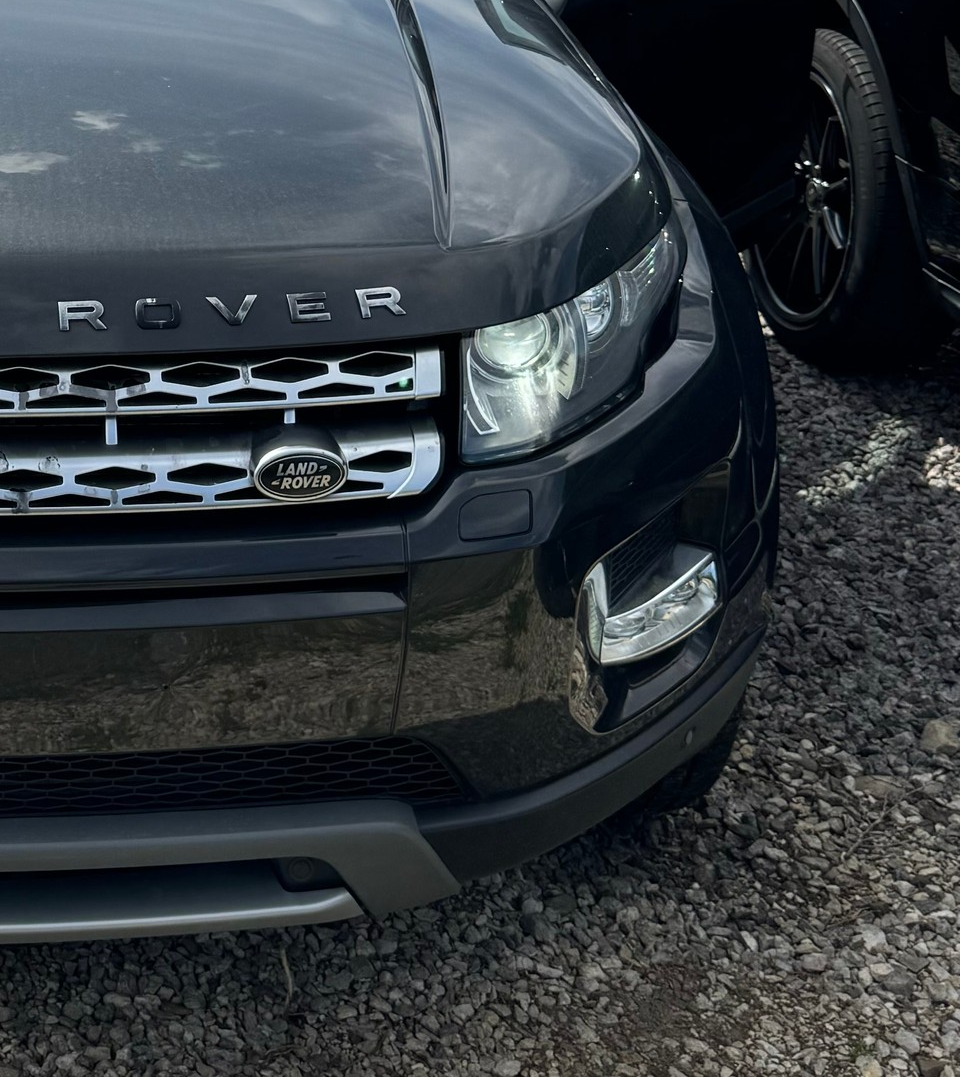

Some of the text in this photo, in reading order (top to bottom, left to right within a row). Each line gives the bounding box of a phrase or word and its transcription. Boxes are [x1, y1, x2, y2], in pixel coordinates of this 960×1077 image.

[57, 285, 407, 332] ROVER
[276, 462, 319, 477] LAND
[280, 475, 331, 490] ROVER
